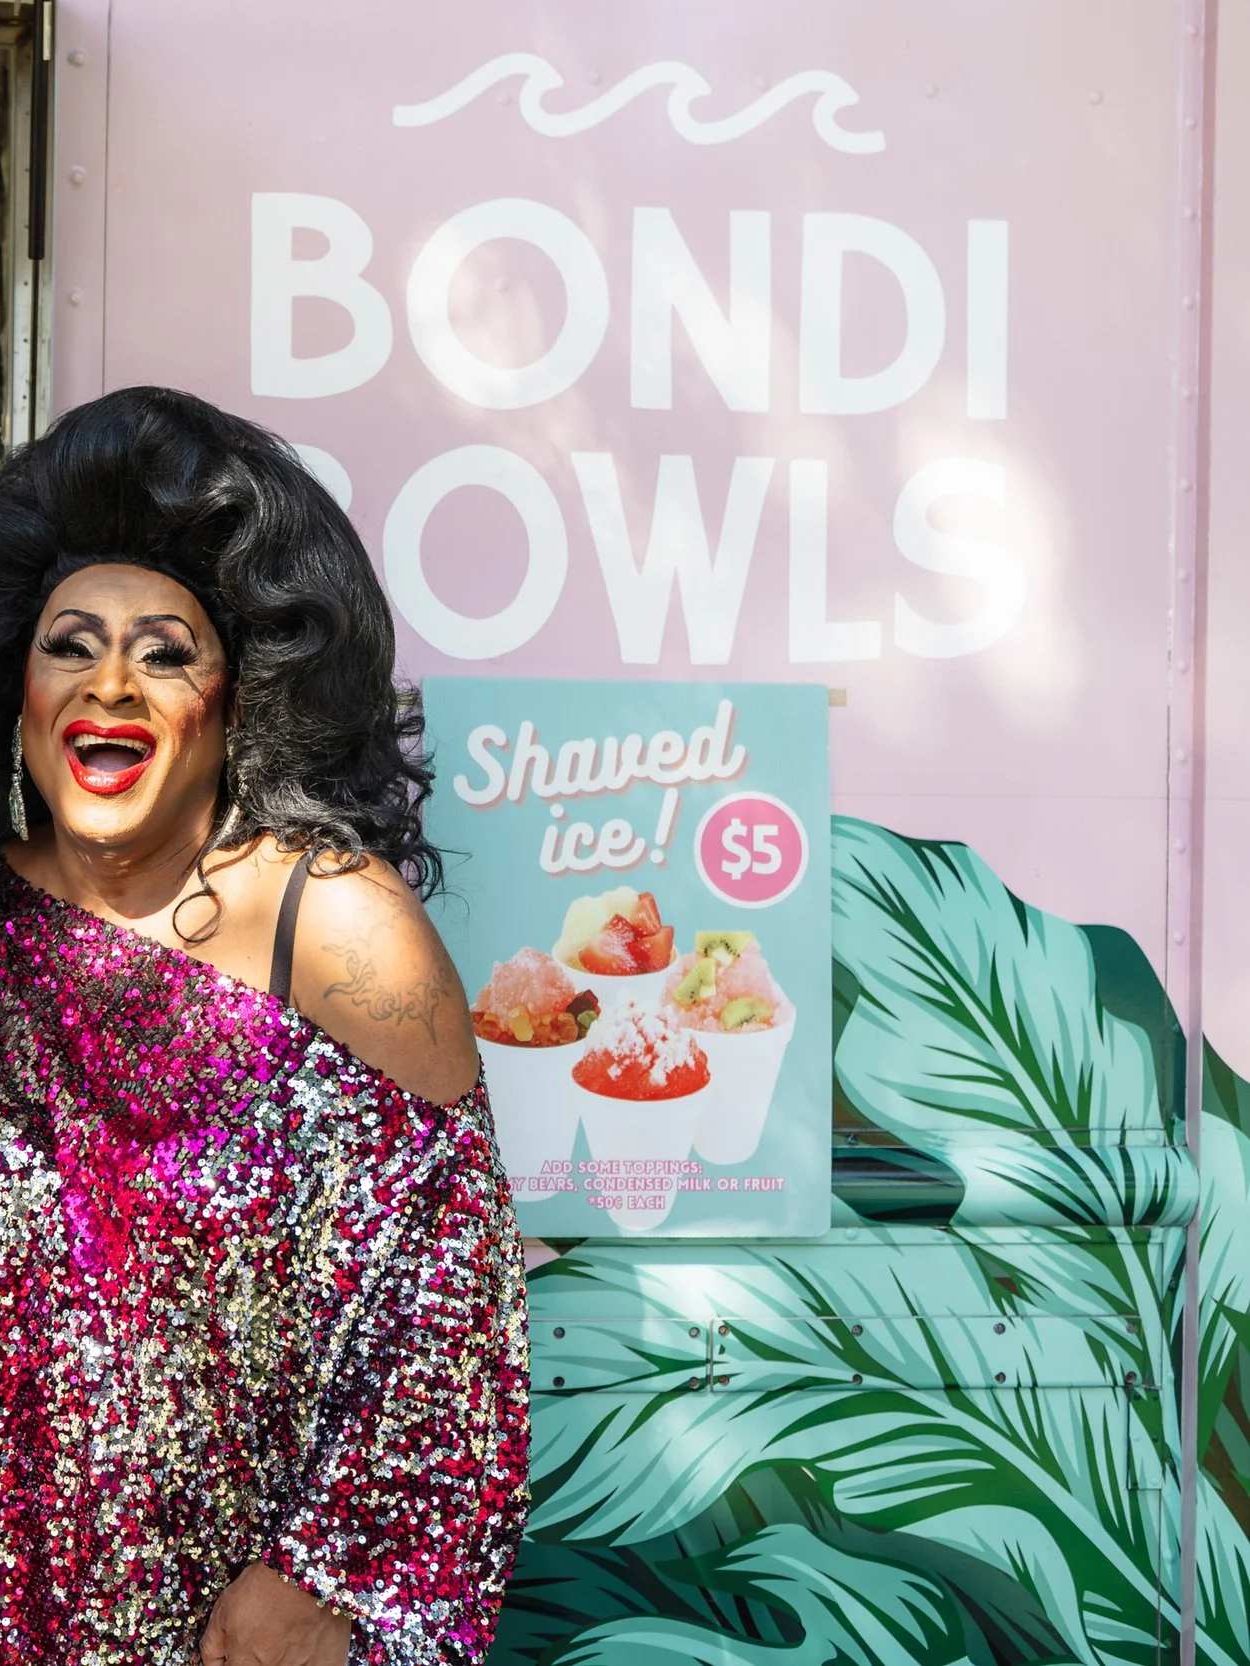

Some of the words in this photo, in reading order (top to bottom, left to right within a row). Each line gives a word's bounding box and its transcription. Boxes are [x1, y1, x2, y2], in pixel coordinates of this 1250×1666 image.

[250, 191, 1009, 420] BONDI
[277, 443, 1027, 665] OWLS
[453, 699, 748, 808] Shaved
[539, 787, 681, 875] ice!
[721, 818, 783, 880] $5
[528, 1177, 580, 1193] BEARS,
[583, 1177, 673, 1192] CONDENSED
[677, 1177, 713, 1192] MILK
[716, 1178, 740, 1192] OR
[743, 1178, 786, 1193] FRUIT
[541, 1160, 573, 1175] ADD
[577, 1160, 620, 1175] SOME
[623, 1160, 703, 1175] TOPPINGS:
[626, 1195, 667, 1210] EACH
